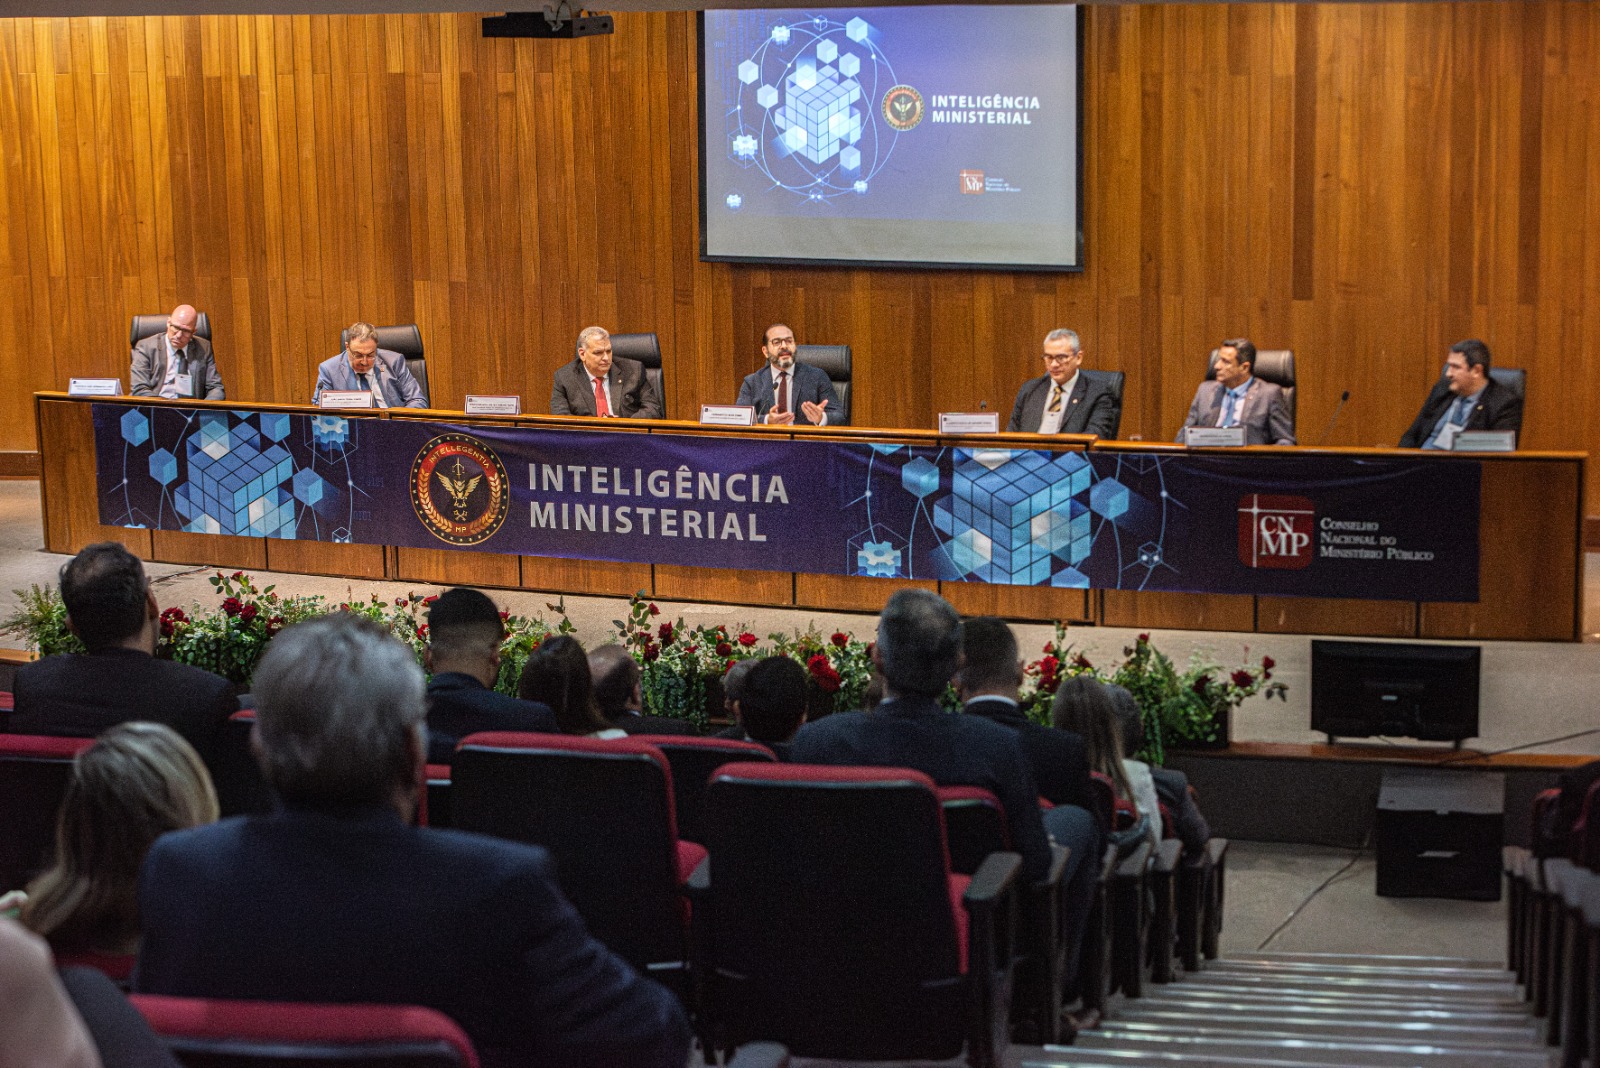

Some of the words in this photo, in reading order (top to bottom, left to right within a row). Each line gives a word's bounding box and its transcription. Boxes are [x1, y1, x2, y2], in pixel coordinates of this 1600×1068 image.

[932, 94, 1040, 109] INTELIGÊNCIA
[932, 111, 1032, 125] MINISTERIAL
[430, 445, 490, 469] INTELLEGENTIA
[528, 463, 789, 504] INTELIGÊNCIA
[530, 501, 767, 542] MINISTERIAL
